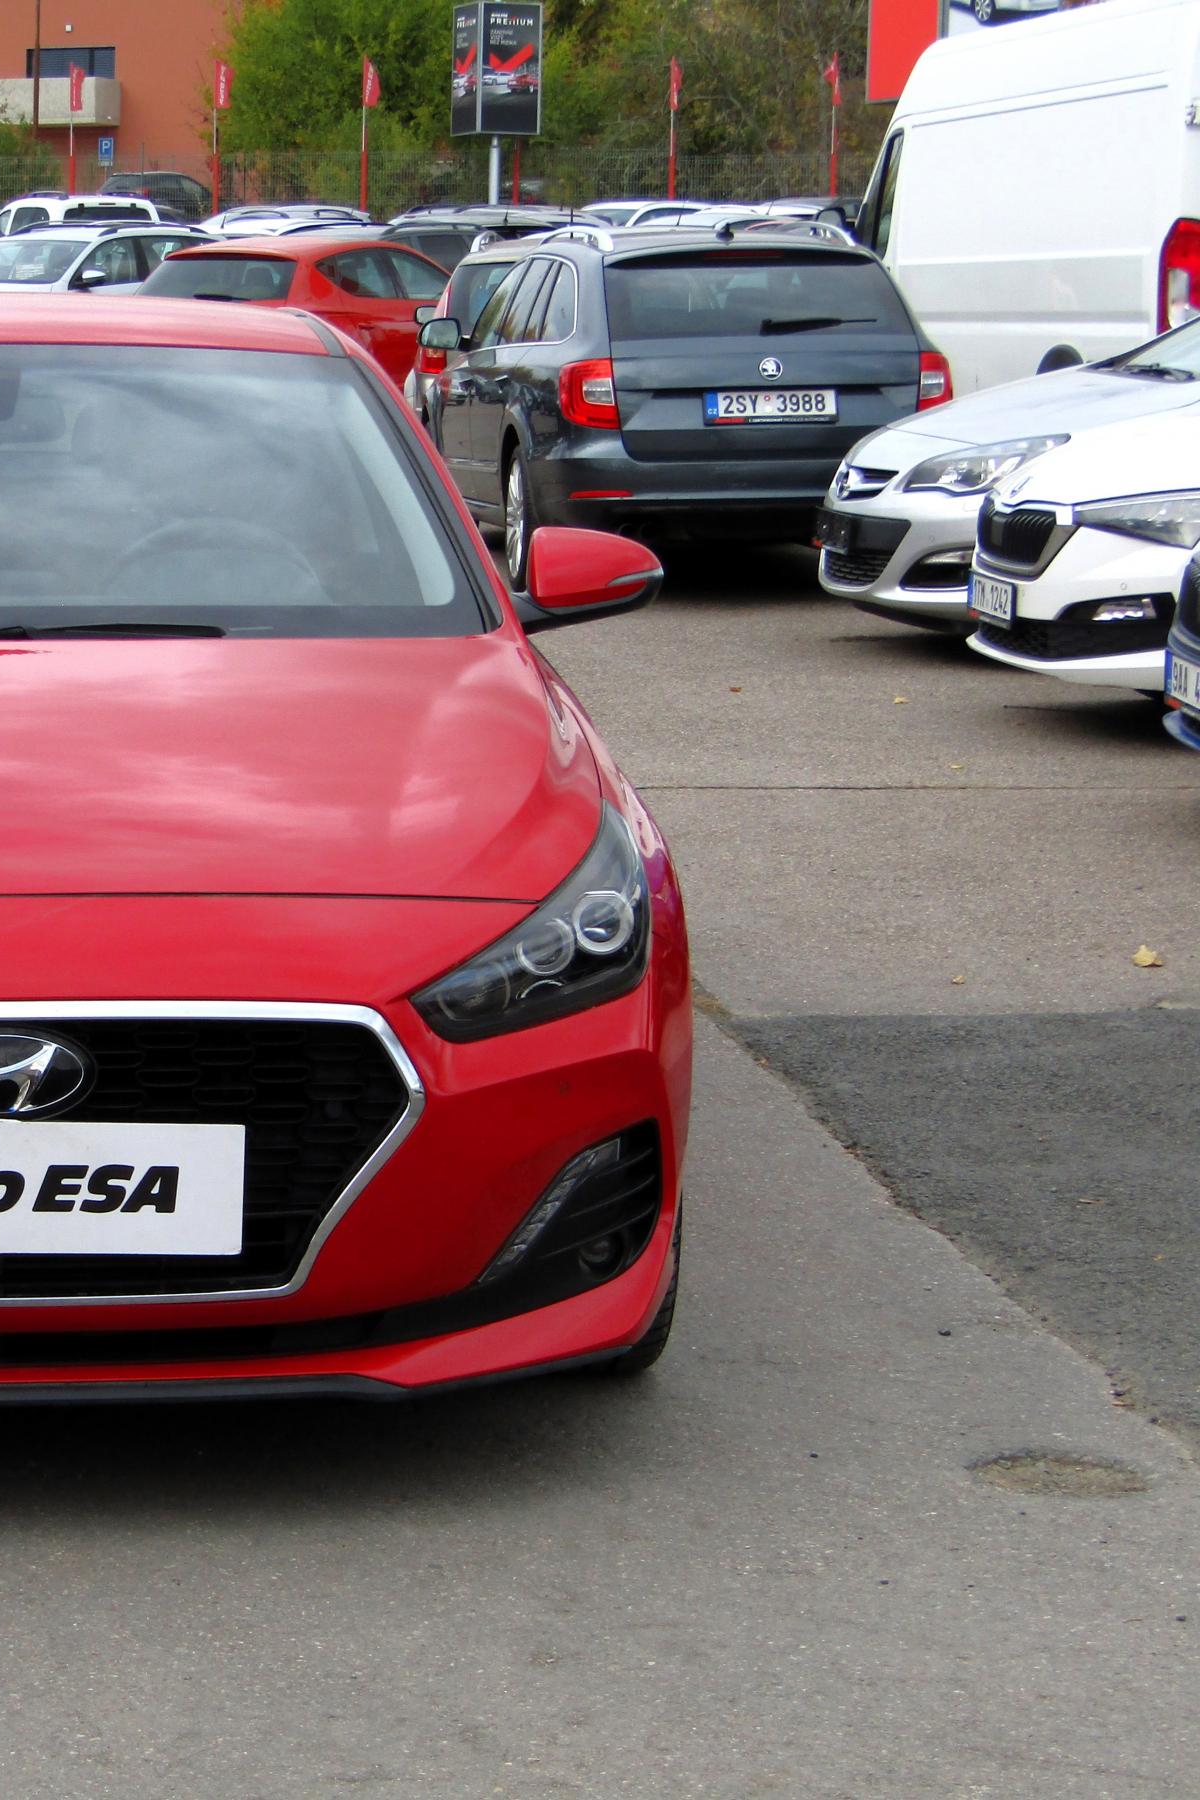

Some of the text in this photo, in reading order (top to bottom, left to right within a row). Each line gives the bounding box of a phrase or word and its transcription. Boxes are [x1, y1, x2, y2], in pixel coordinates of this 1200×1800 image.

[102, 141, 111, 153] P
[722, 393, 826, 415] 2SY 3988
[990, 584, 1009, 615] 1242
[1172, 661, 1188, 698] 9AA
[31, 1163, 181, 1214] ESA
